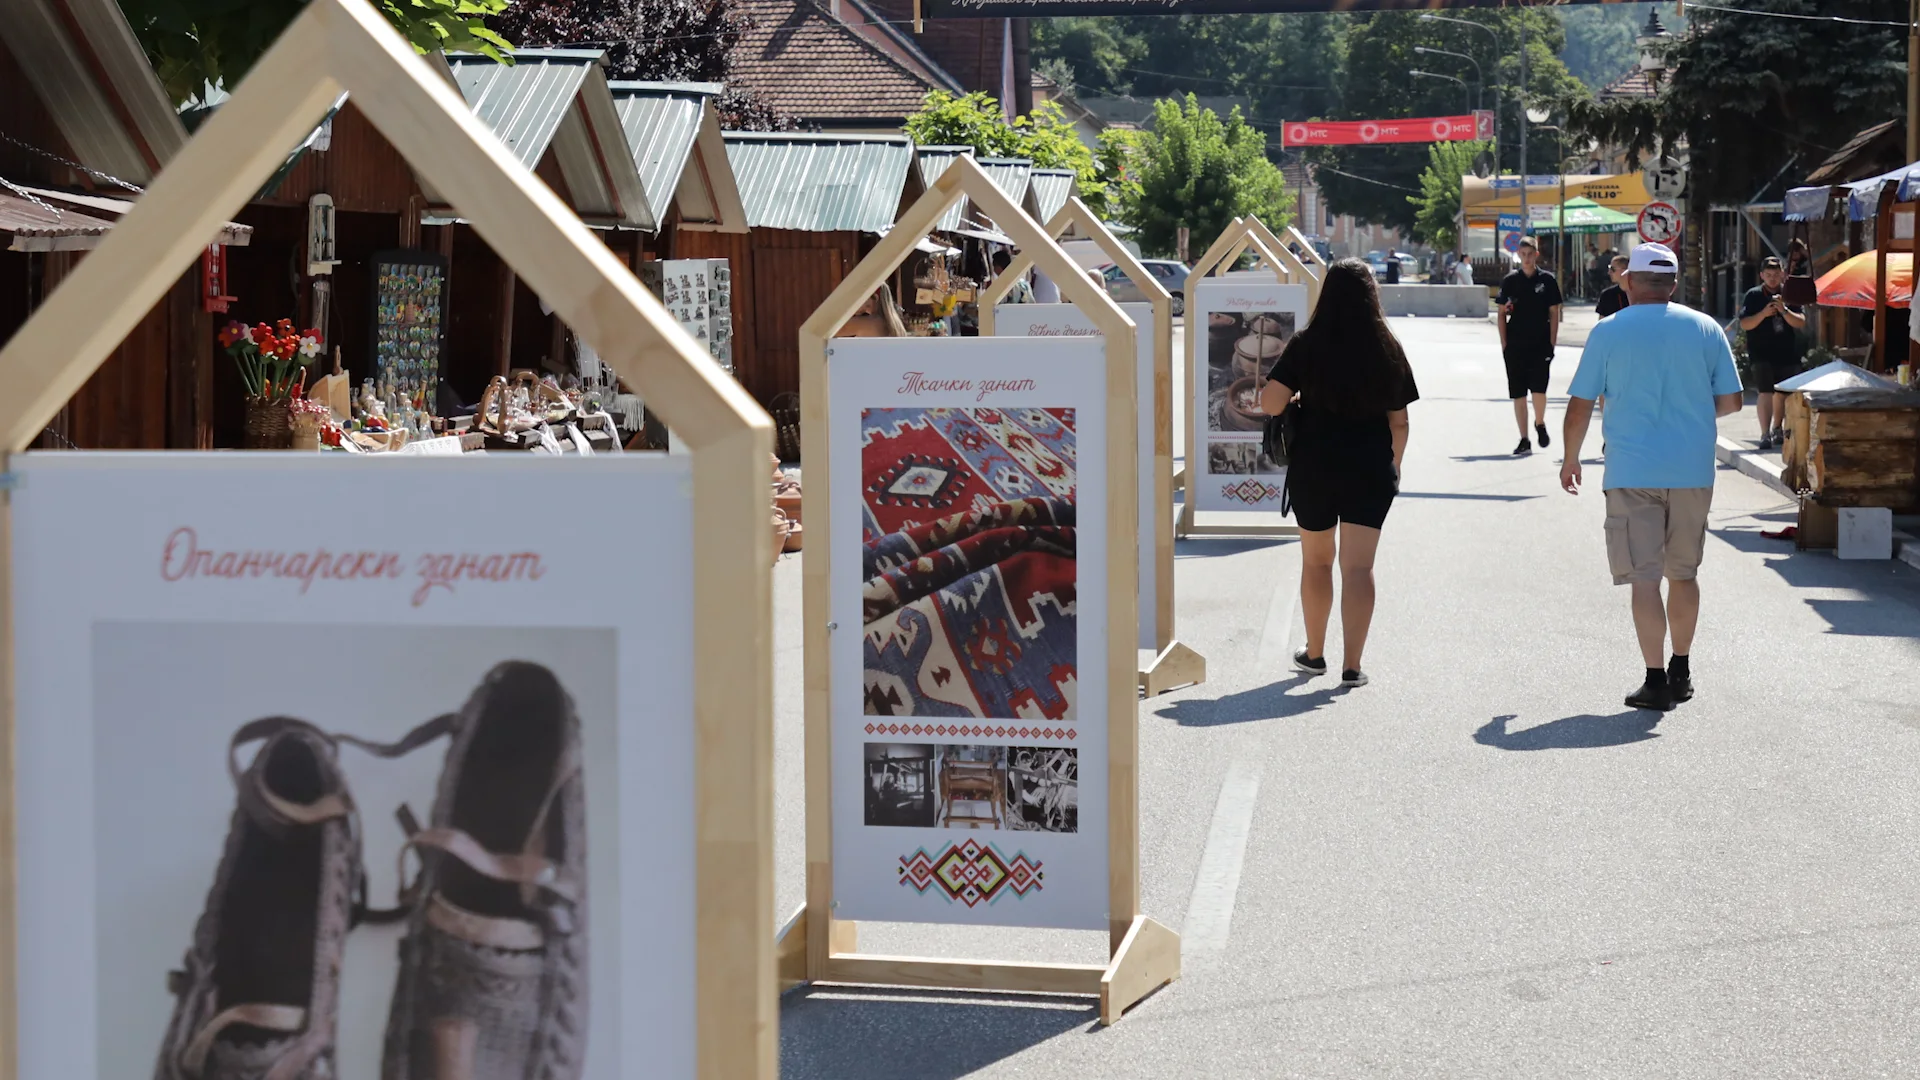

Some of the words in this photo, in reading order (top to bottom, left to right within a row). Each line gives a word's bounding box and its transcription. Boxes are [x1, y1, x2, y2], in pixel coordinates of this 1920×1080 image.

[1028, 323, 1060, 336] Ethnic
[1062, 324, 1089, 336] dress
[976, 379, 1037, 402] занат
[411, 549, 547, 608] занат
